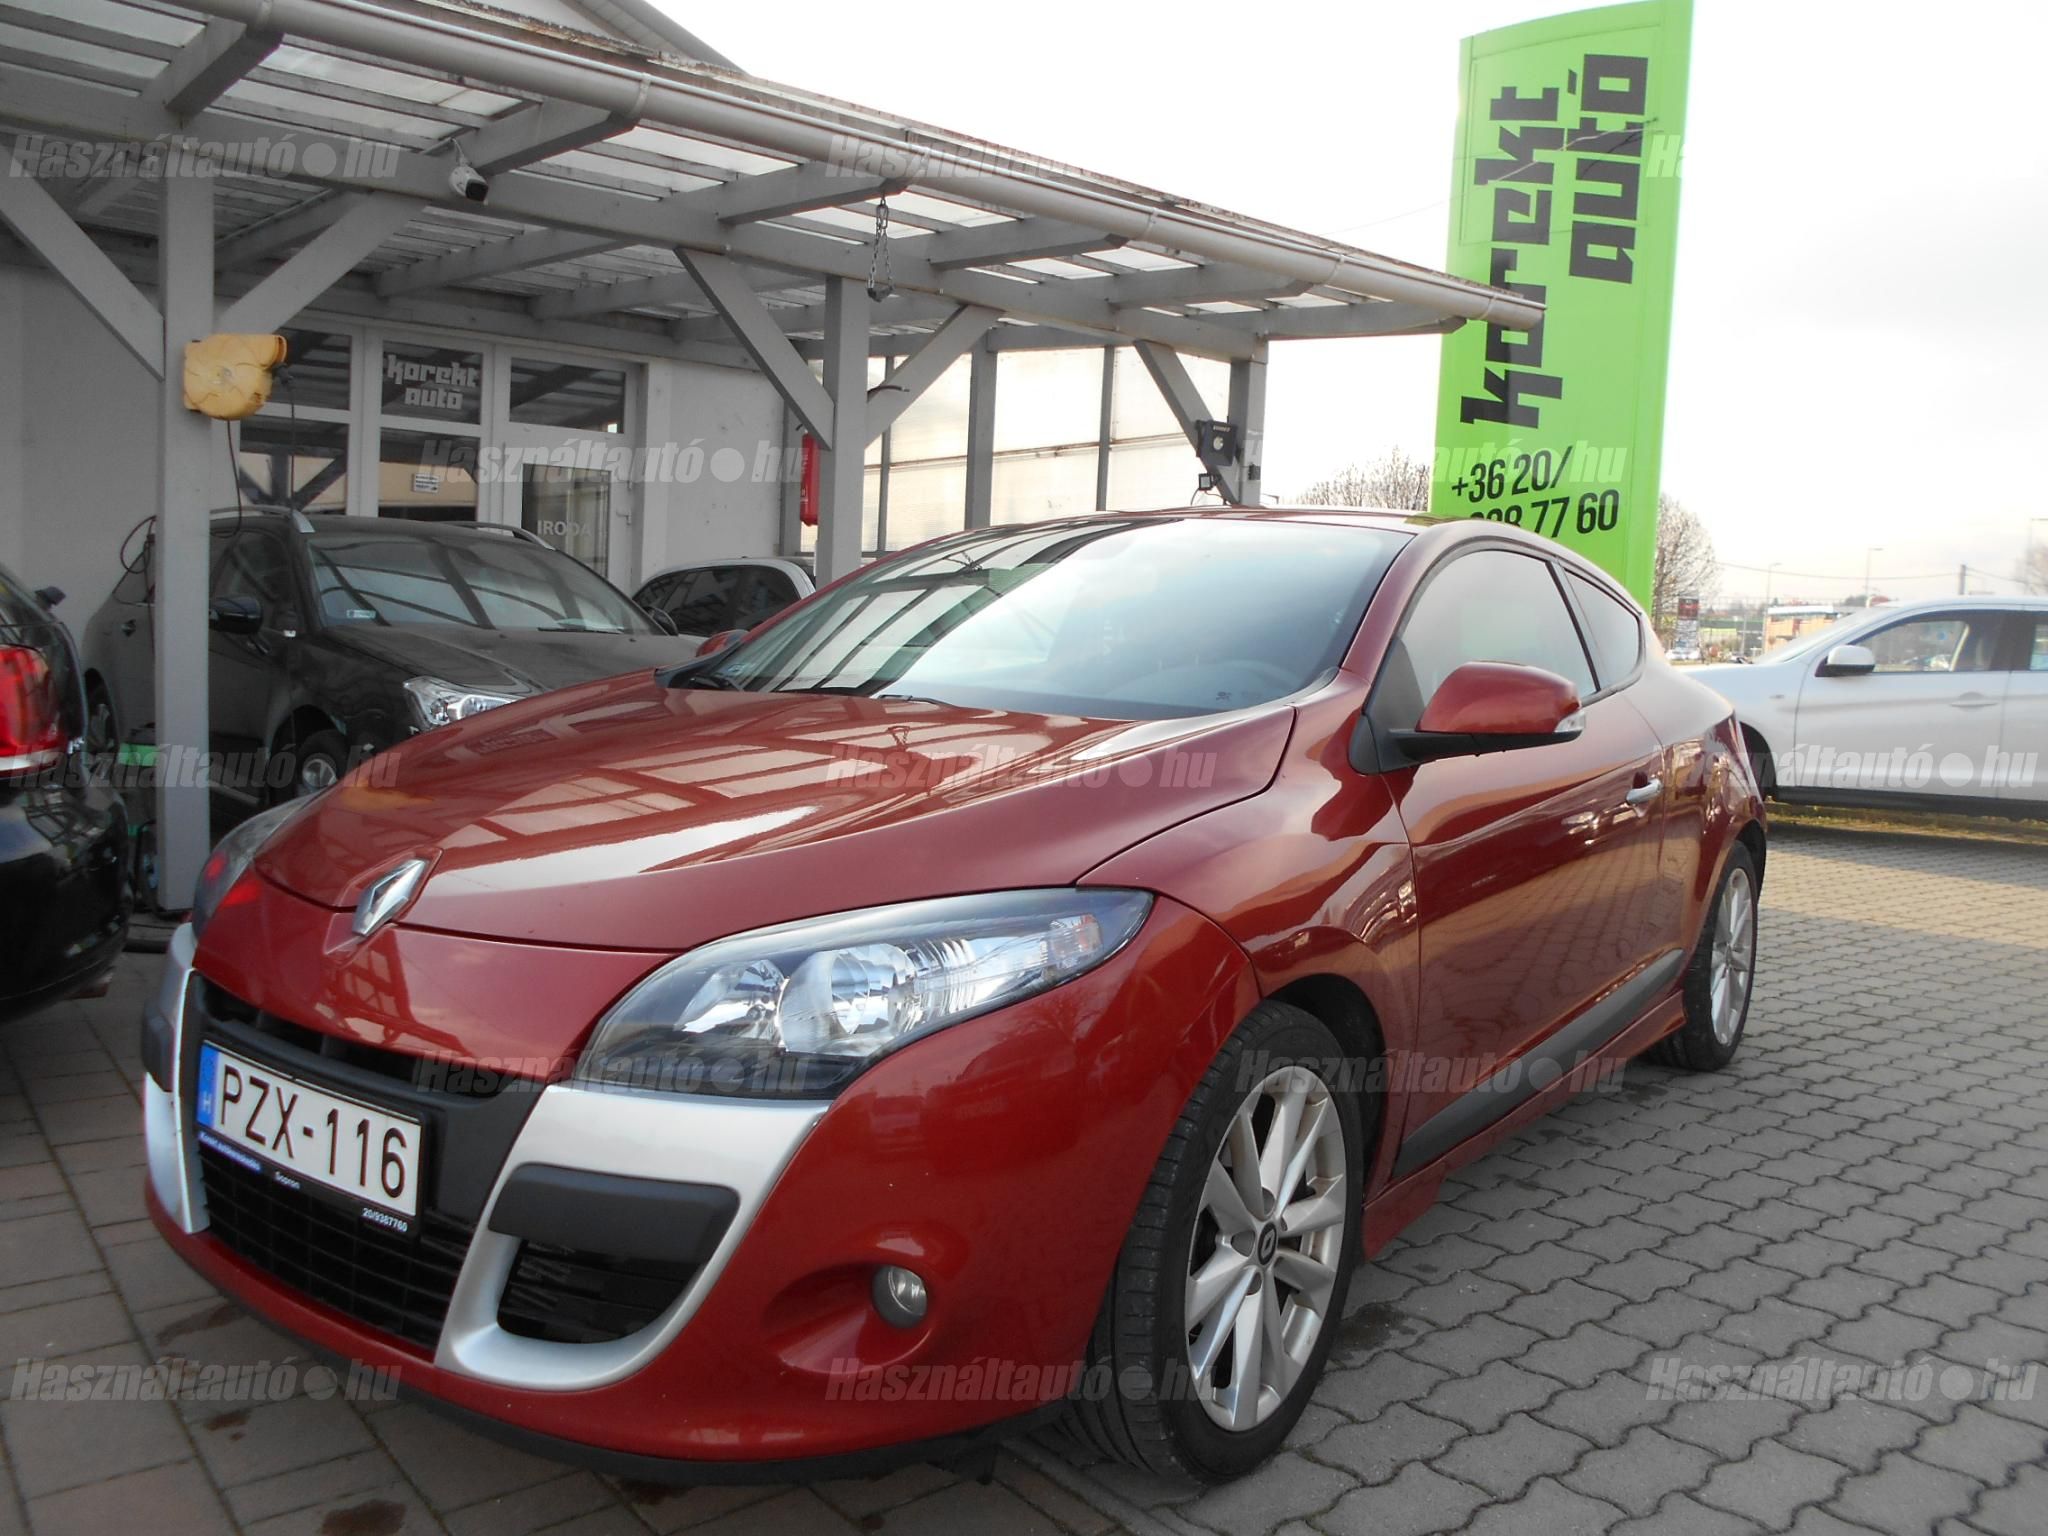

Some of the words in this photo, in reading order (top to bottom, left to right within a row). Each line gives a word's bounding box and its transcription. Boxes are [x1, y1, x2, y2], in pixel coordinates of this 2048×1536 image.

[1452, 458, 1505, 503] +36
[1511, 446, 1573, 495] 20/
[537, 519, 592, 537] IRODA
[1576, 489, 1620, 534] 60
[221, 1063, 408, 1199] PZX-116
